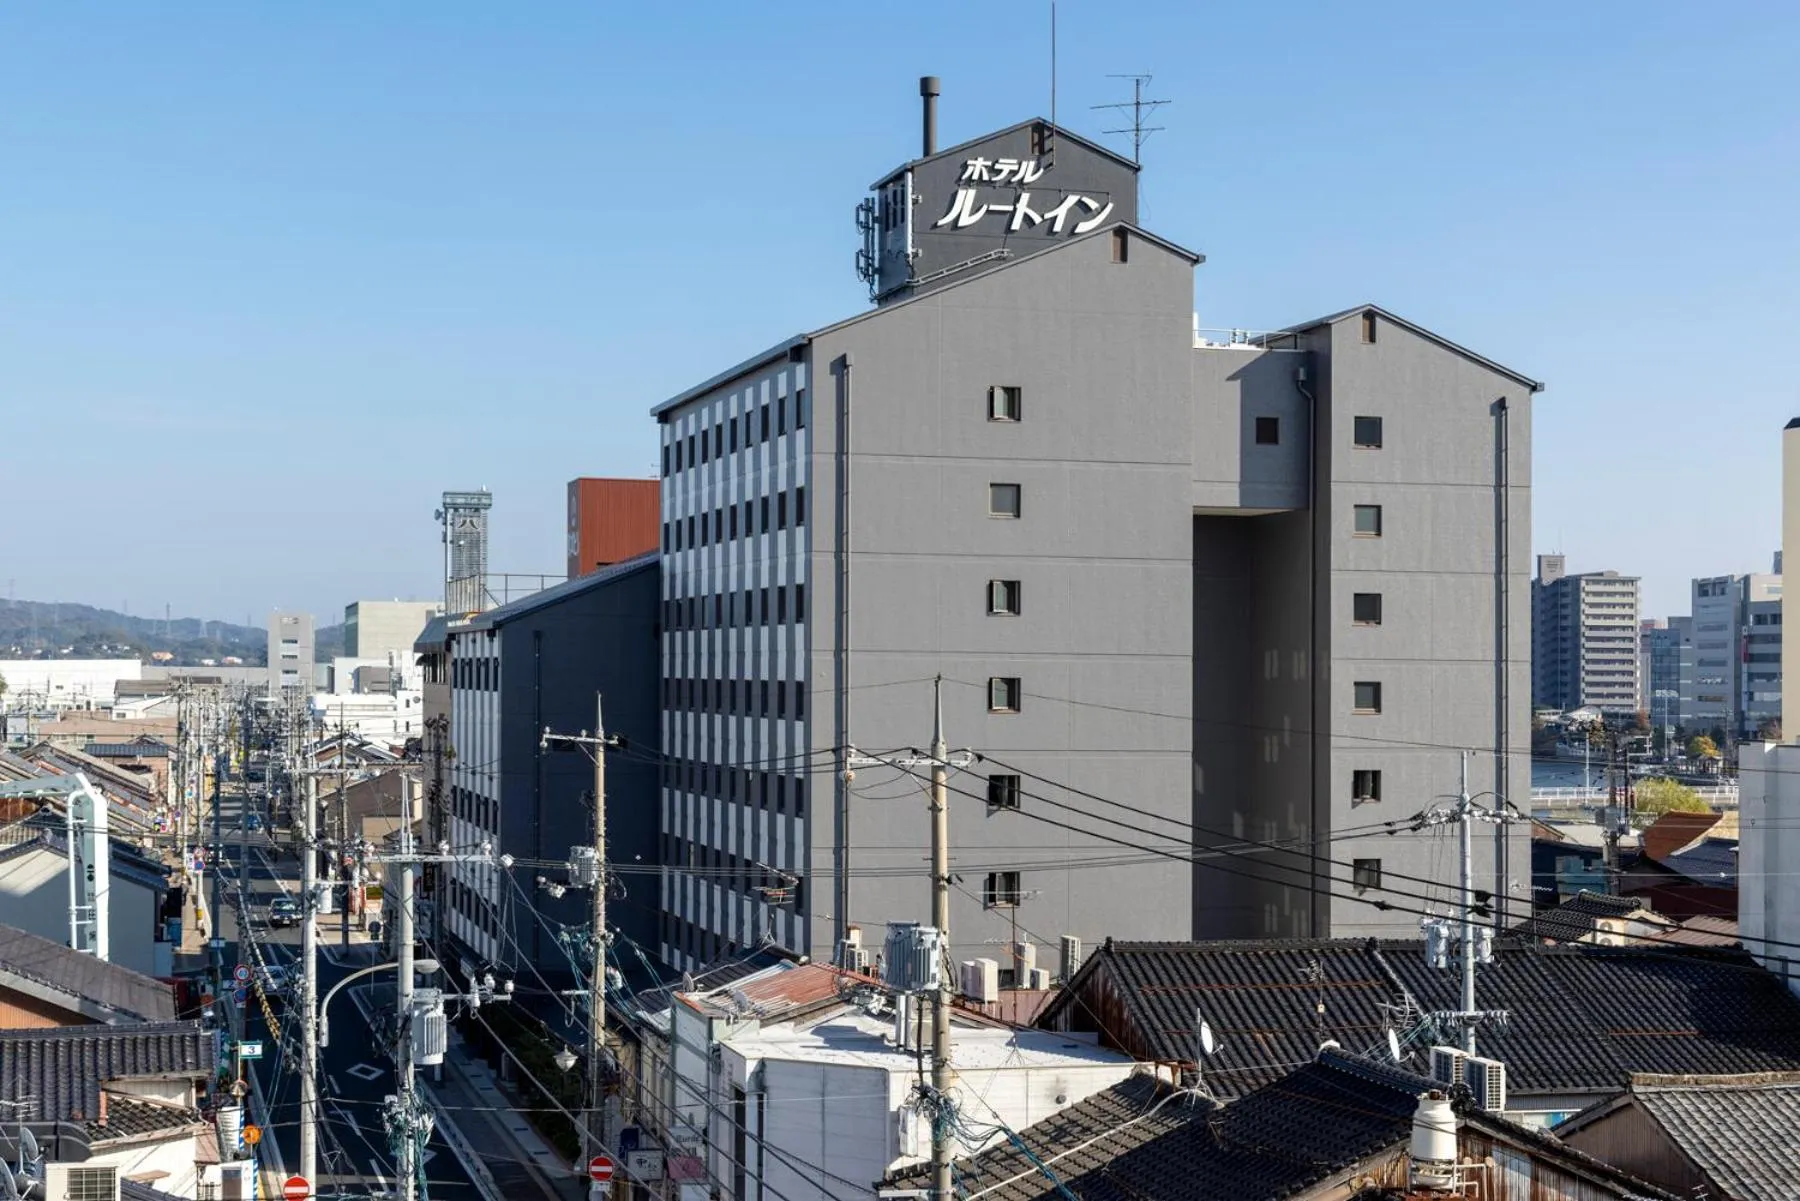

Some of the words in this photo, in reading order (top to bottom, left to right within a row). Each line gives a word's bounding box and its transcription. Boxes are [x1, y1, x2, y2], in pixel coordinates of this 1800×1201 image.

[961, 156, 1044, 183] ホテル
[937, 188, 1114, 234] ルートイン
[248, 1045, 256, 1055] 3
